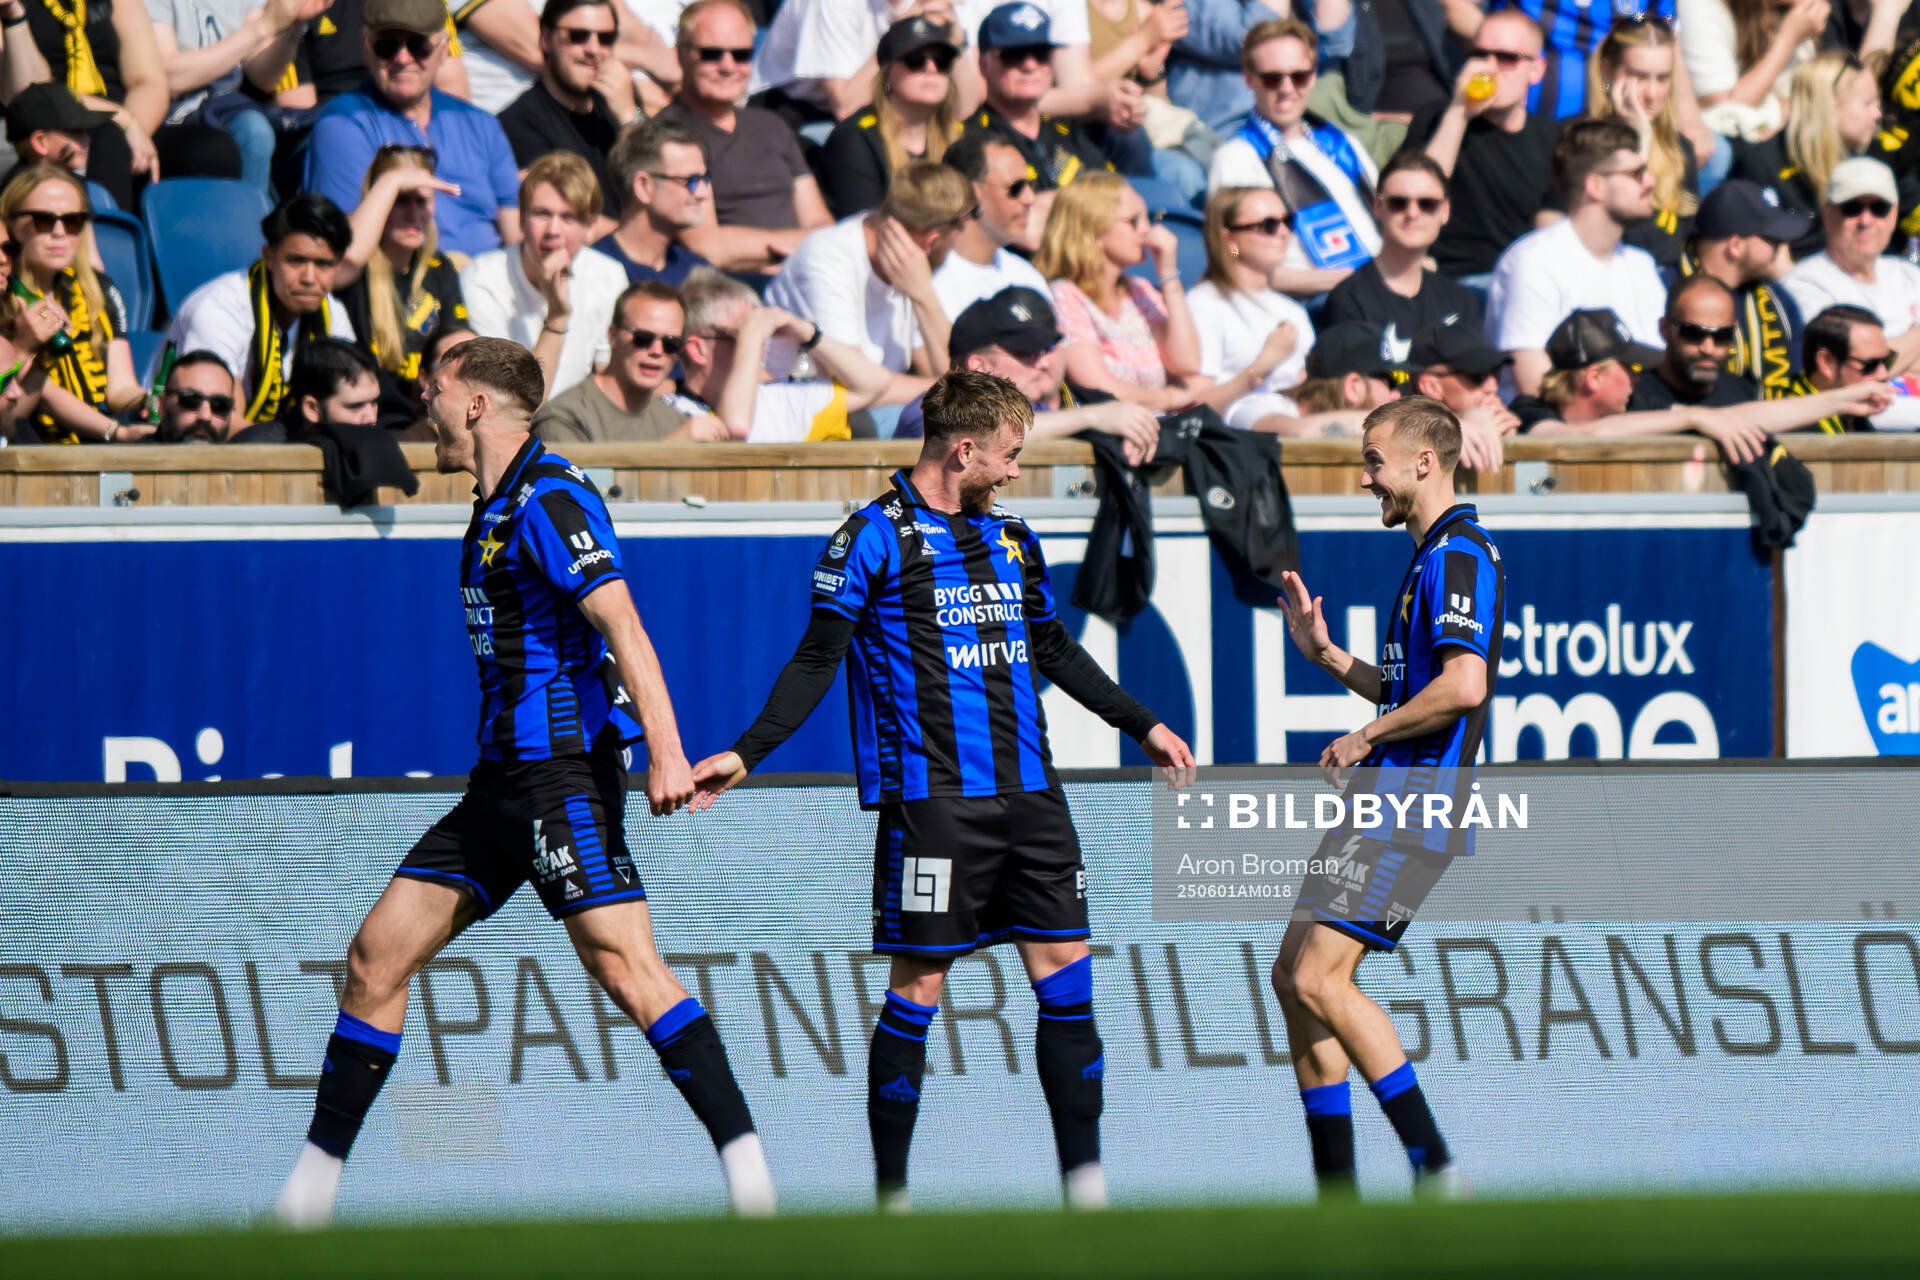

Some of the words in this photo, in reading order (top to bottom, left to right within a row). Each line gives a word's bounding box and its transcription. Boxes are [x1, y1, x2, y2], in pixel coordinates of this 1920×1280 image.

[813, 570, 846, 587] UNIBET
[934, 585, 982, 606] BYGG
[936, 603, 1024, 627] CONSTRUCT
[1434, 610, 1484, 635] unisport
[1497, 603, 1695, 678] ctrolux
[1344, 881, 1362, 892] DATA
[1328, 902, 1350, 915] SELECT
[1089, 941, 1293, 1069] ILL
